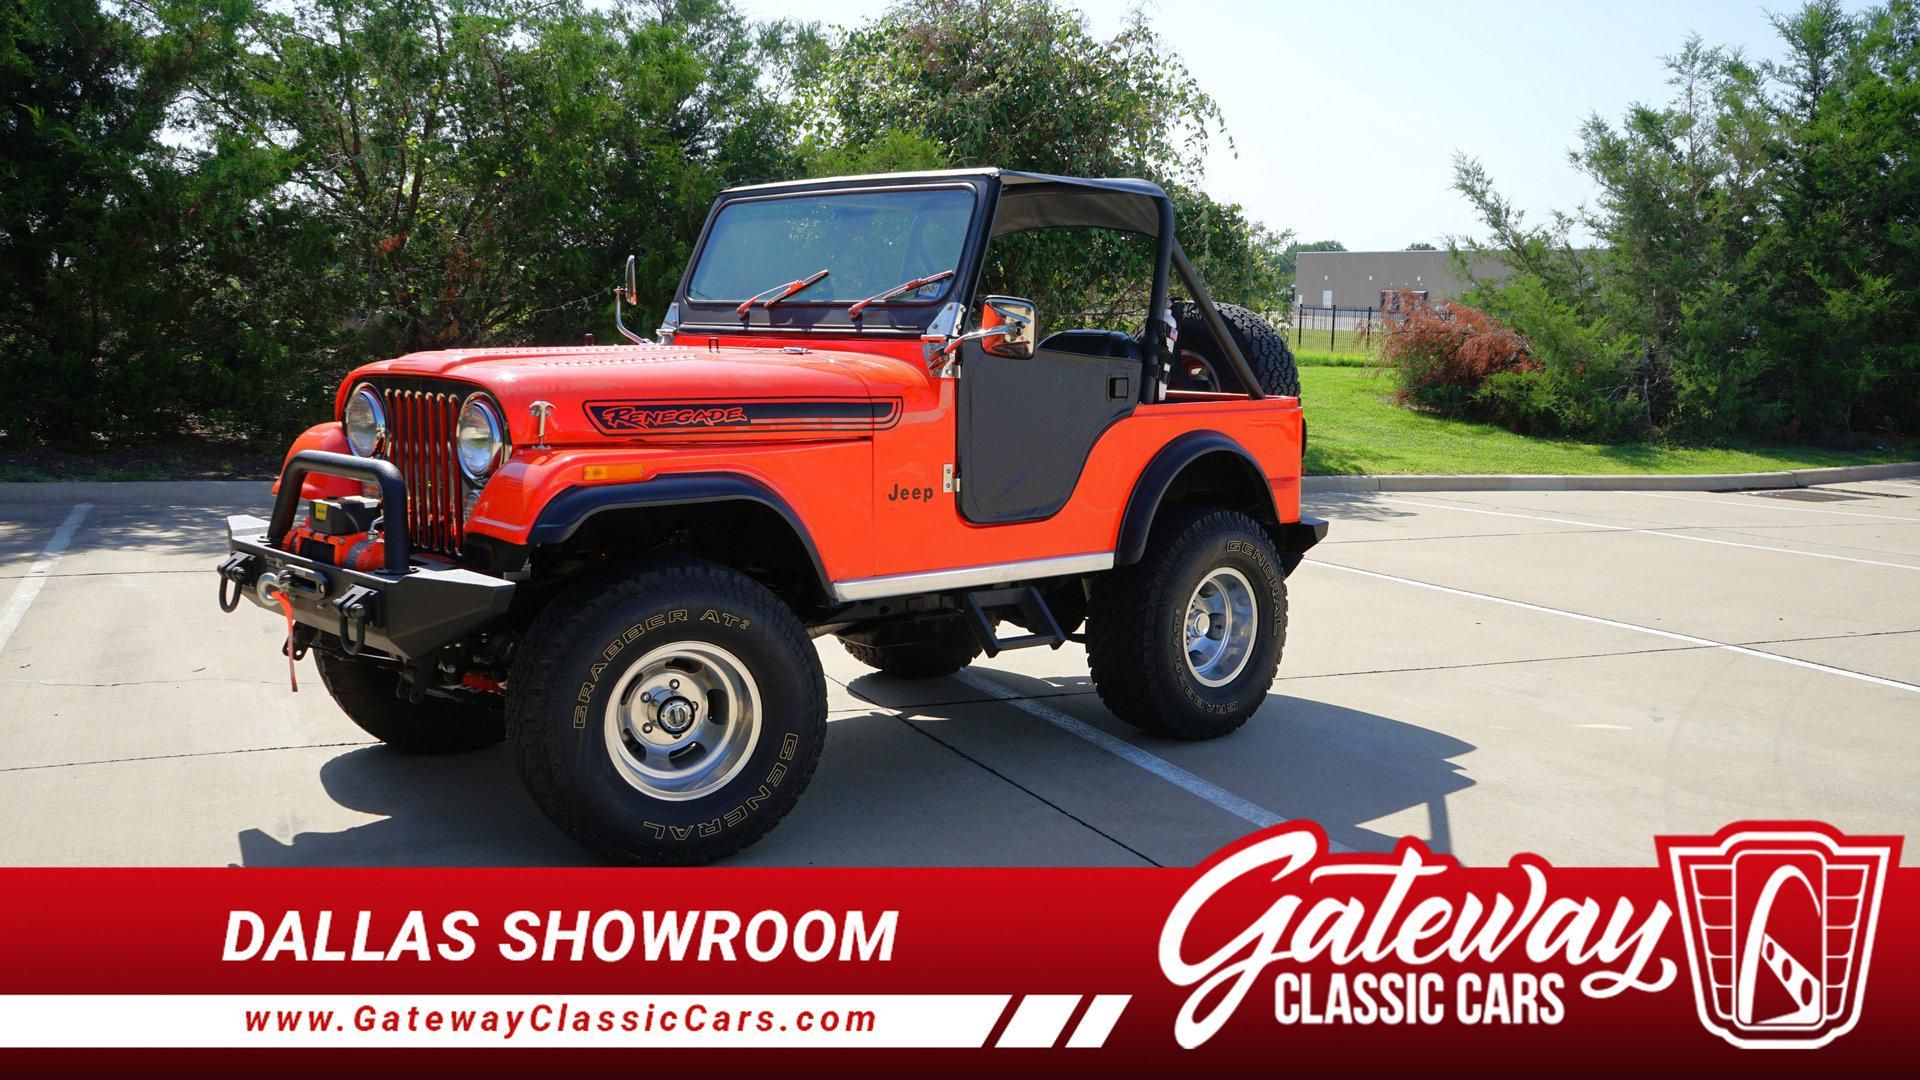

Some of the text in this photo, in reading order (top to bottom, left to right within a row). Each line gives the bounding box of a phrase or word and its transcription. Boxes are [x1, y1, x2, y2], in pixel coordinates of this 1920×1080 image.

[602, 406, 748, 429] RENEGADE
[888, 484, 934, 503] Jeep
[1226, 540, 1287, 636] GENERAL
[572, 608, 688, 729] GRABBER
[643, 732, 799, 841] GENERAL
